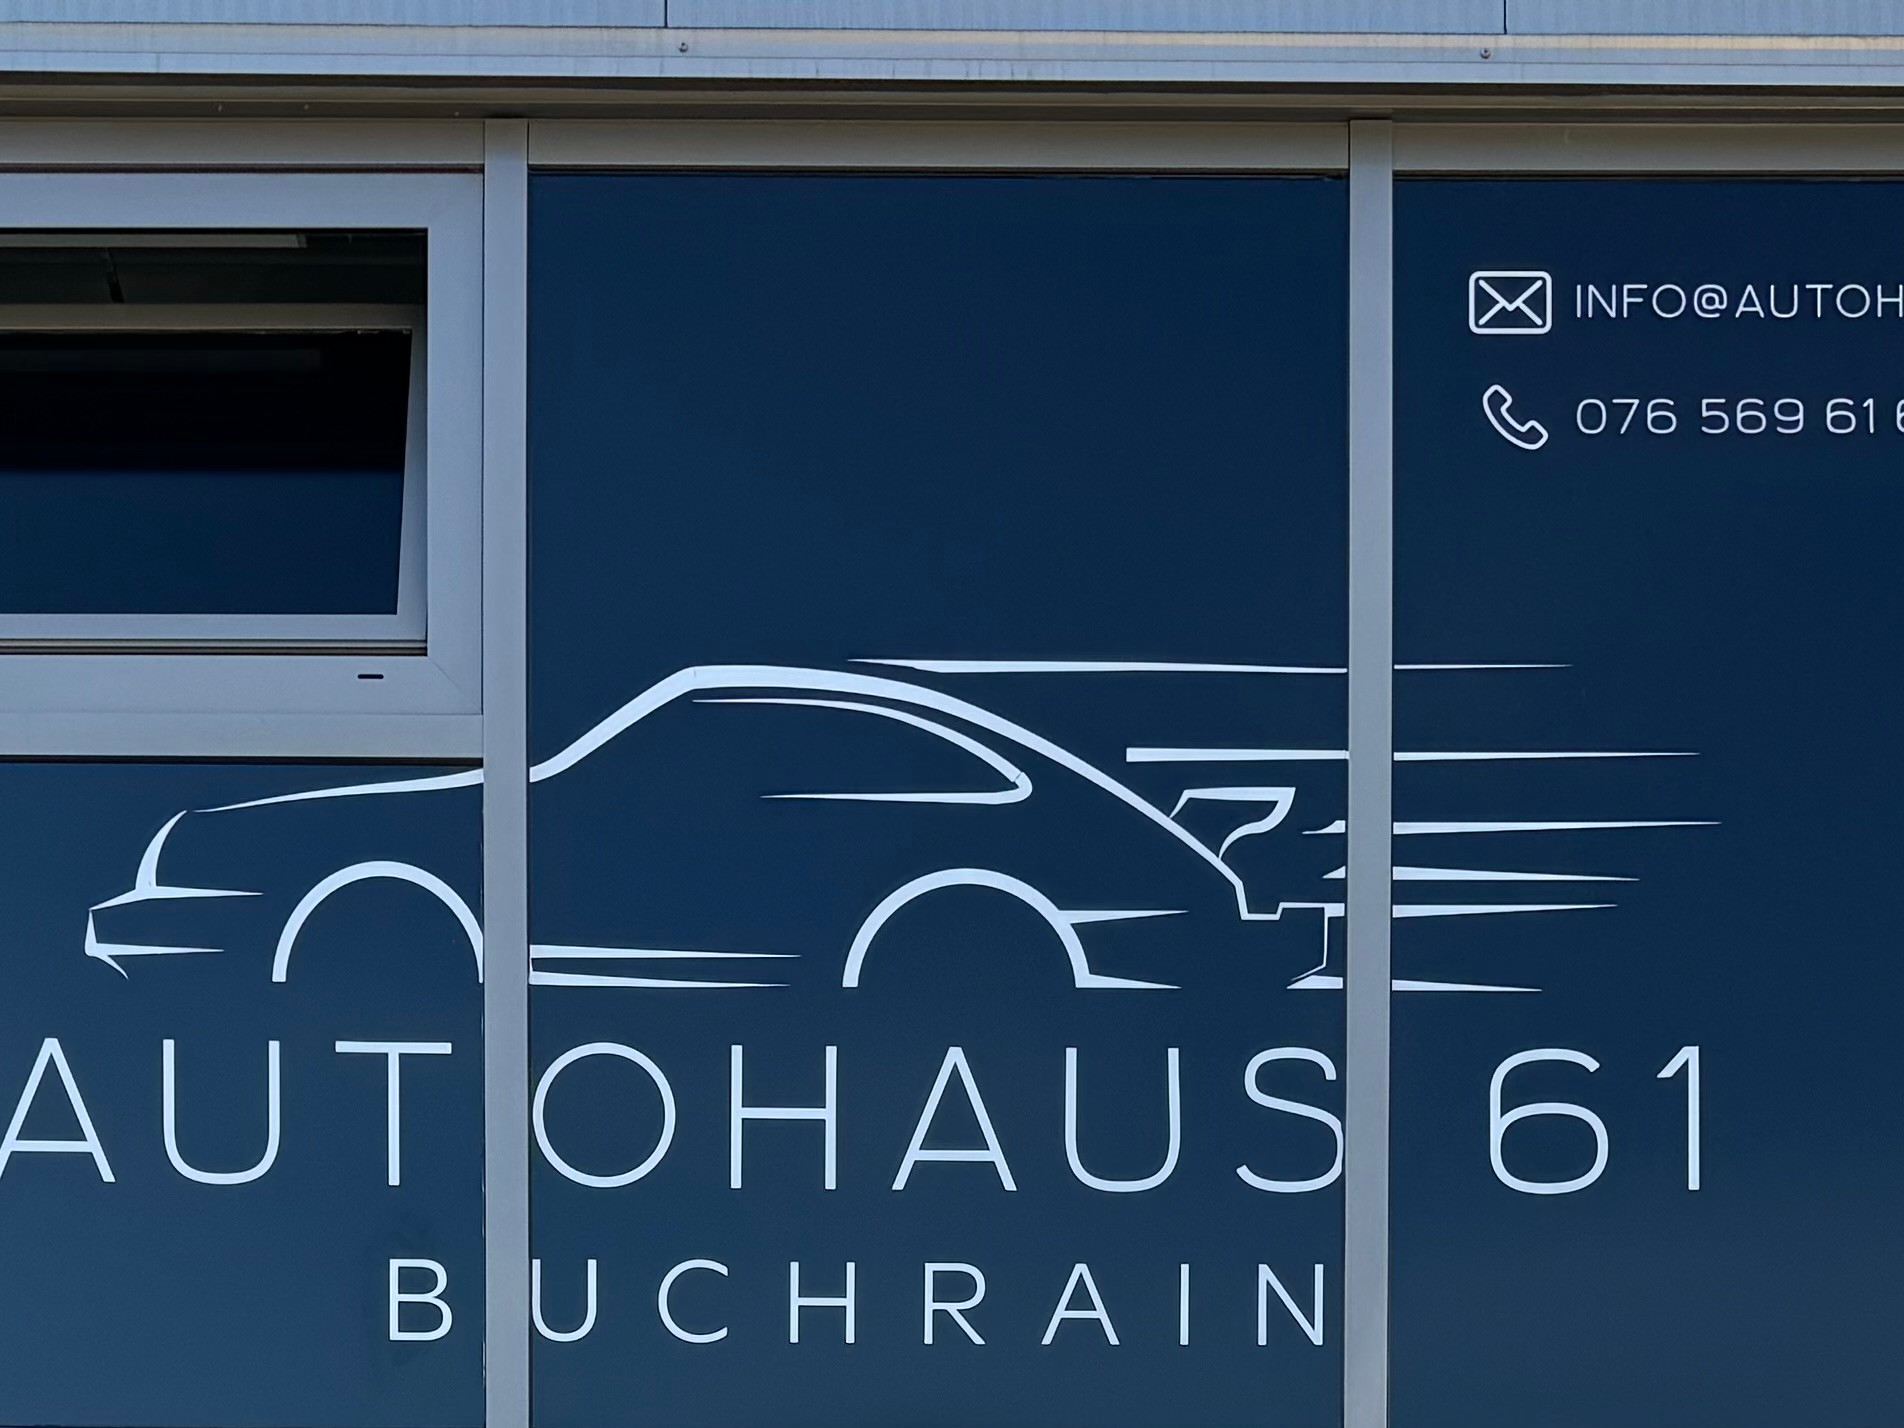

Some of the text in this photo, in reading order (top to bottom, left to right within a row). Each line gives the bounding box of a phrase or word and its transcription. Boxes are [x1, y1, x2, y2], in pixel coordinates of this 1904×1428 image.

[1576, 398, 1677, 434] 076
[1701, 398, 1804, 434] 569
[1826, 398, 1875, 434] 61
[1489, 1045, 1700, 1195] 61
[389, 1258, 1324, 1346] BUCHRAIN
